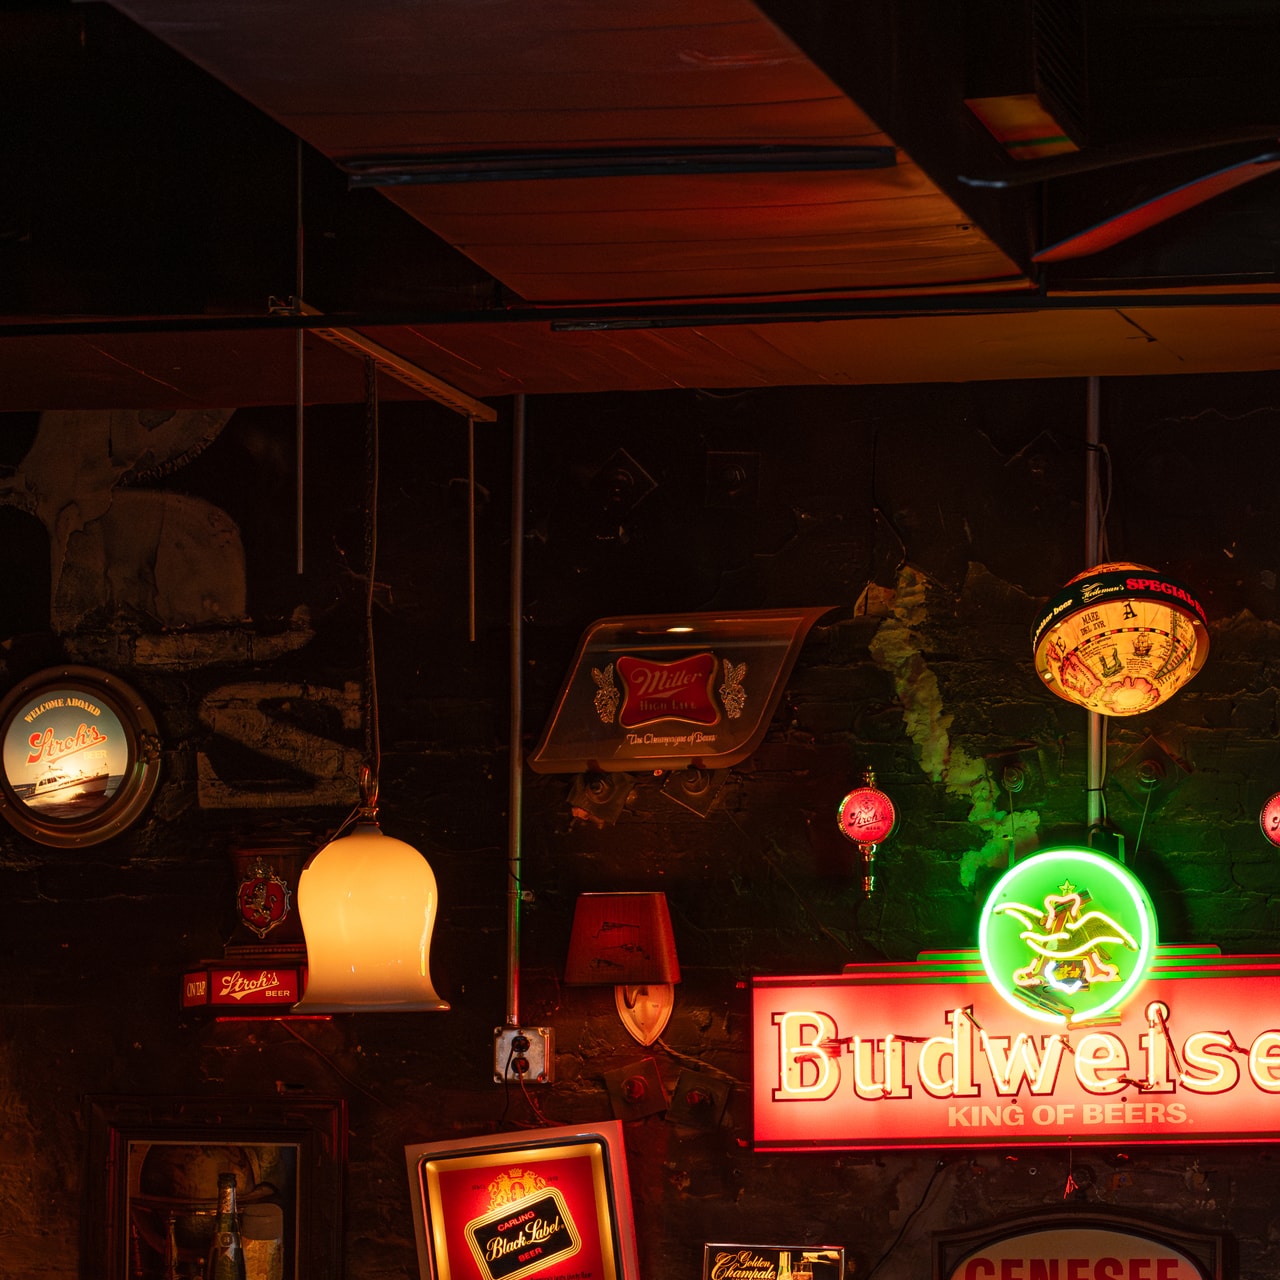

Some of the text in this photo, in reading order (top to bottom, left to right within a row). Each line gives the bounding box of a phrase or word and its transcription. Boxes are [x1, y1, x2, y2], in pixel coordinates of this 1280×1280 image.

[1126, 578, 1195, 607] SPECIAL
[630, 667, 703, 697] Miller
[24, 697, 102, 724] WELCOME ABOARD
[640, 699, 697, 711] HIGH LIFE
[25, 723, 108, 766] Stroh's
[626, 734, 643, 745] The
[644, 733, 687, 746] Champagne
[83, 750, 107, 760] BEER
[847, 811, 888, 828] Stroh's
[187, 981, 207, 997] ON TAP
[219, 971, 280, 1000] Stroh's
[947, 1103, 1188, 1127] KING OF BEERS
[497, 1210, 536, 1232] CARLING
[486, 1216, 560, 1262] Black Label
[517, 1247, 543, 1262] BEER
[738, 1251, 771, 1268] Golden
